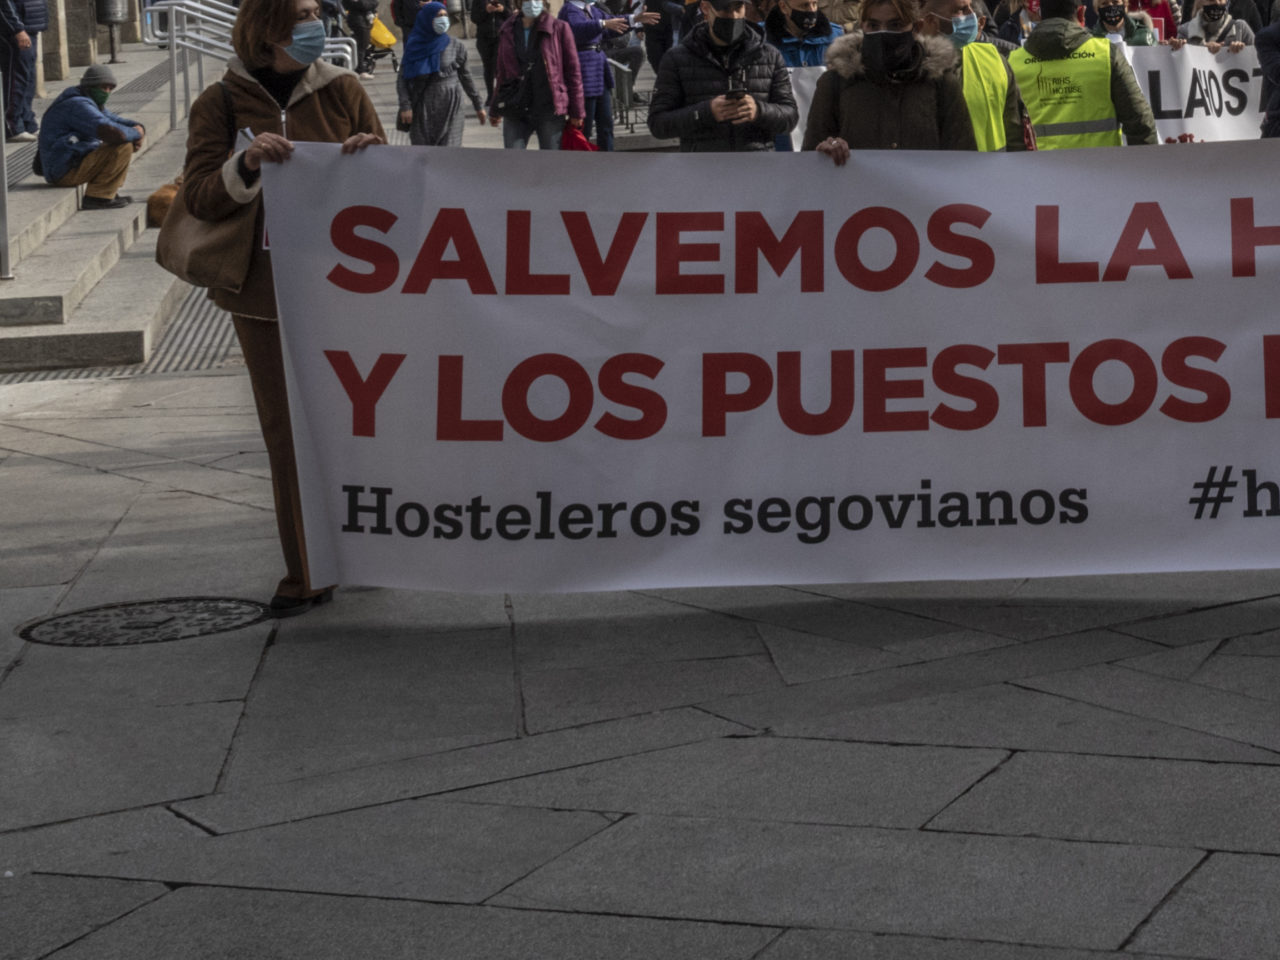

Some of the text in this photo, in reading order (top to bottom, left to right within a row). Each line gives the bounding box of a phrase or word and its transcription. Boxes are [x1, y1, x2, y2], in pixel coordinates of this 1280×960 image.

[1148, 68, 1211, 119] LA
[327, 204, 995, 296] SALVEMOS
[1035, 202, 1193, 284] LA
[324, 350, 406, 437] Y
[435, 351, 668, 442] LOS
[702, 336, 1231, 437] PUESTOS
[341, 484, 702, 542] Hosteleros
[723, 479, 1089, 545] segovianos
